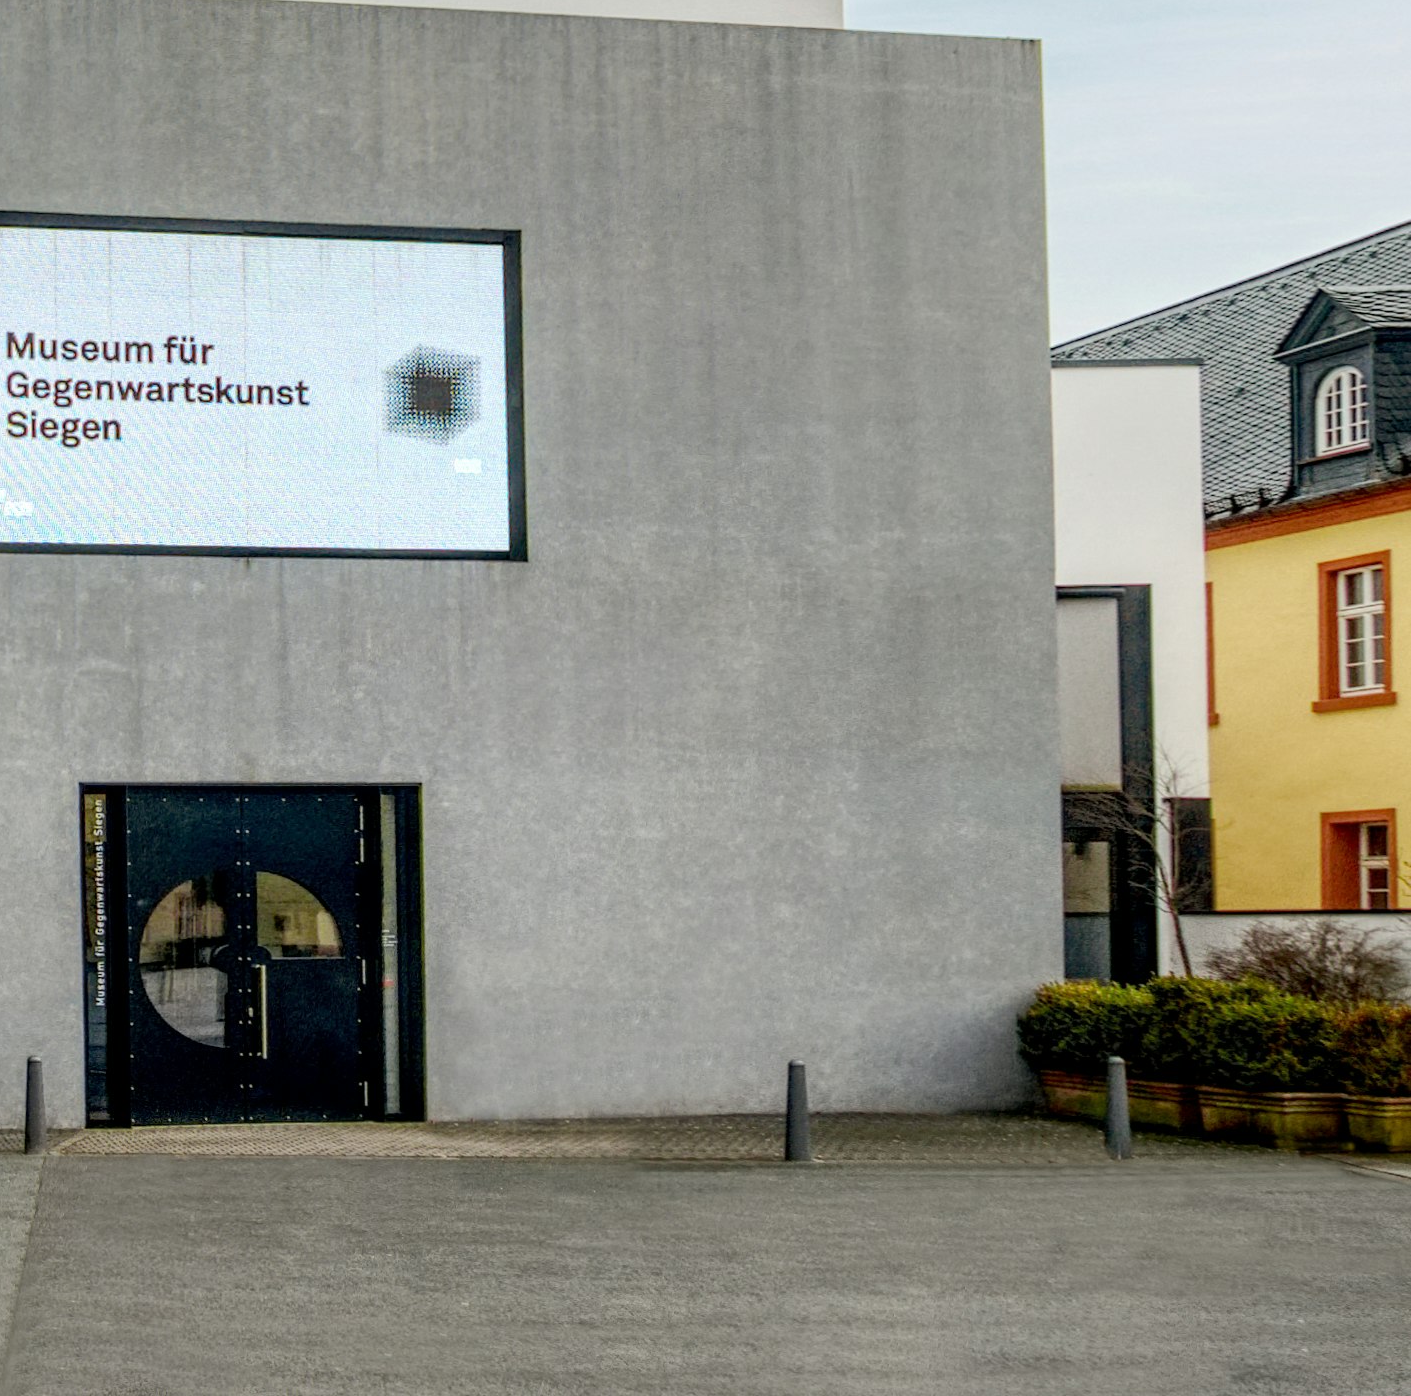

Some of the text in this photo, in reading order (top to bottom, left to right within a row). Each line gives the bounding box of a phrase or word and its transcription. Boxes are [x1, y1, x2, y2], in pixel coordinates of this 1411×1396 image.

[6, 332, 214, 365] Museum für
[6, 371, 310, 408] Gegenwartskunst
[6, 410, 122, 448] Siegen
[94, 799, 107, 1006] Museum für Gegenwartskunst Siegen
